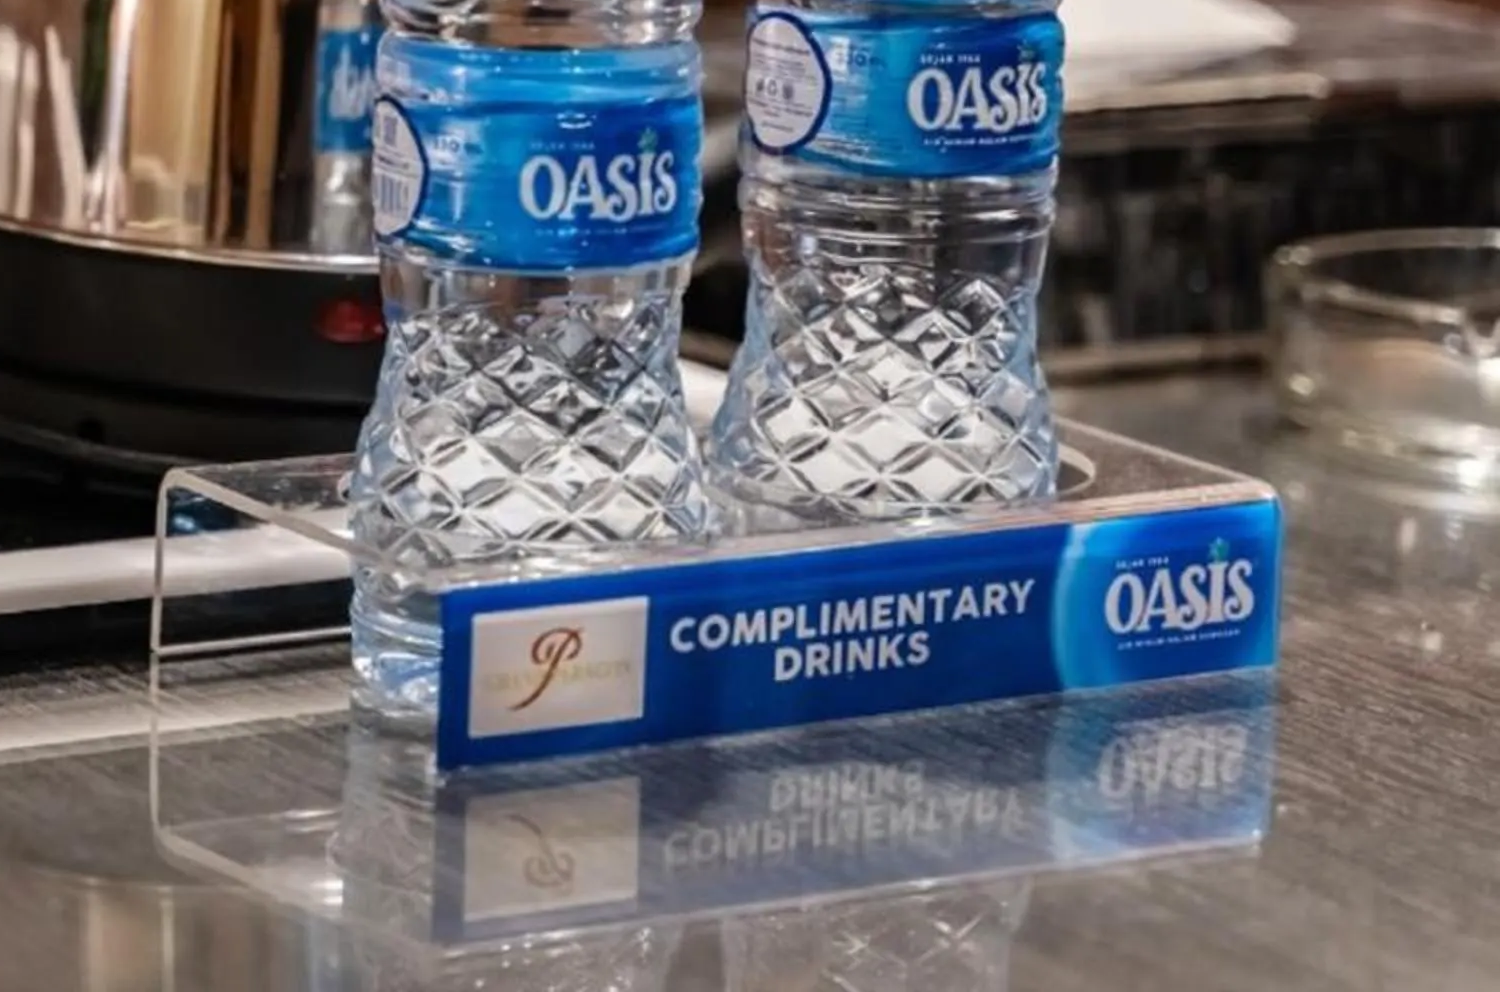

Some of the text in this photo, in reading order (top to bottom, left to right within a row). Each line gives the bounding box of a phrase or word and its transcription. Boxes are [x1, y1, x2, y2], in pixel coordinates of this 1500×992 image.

[907, 62, 1047, 134] OASIS
[519, 151, 677, 223] OASIS
[669, 579, 1035, 653] COMPLIMENTARY
[1104, 559, 1255, 634] OASIS
[774, 631, 931, 682] DRINKS
